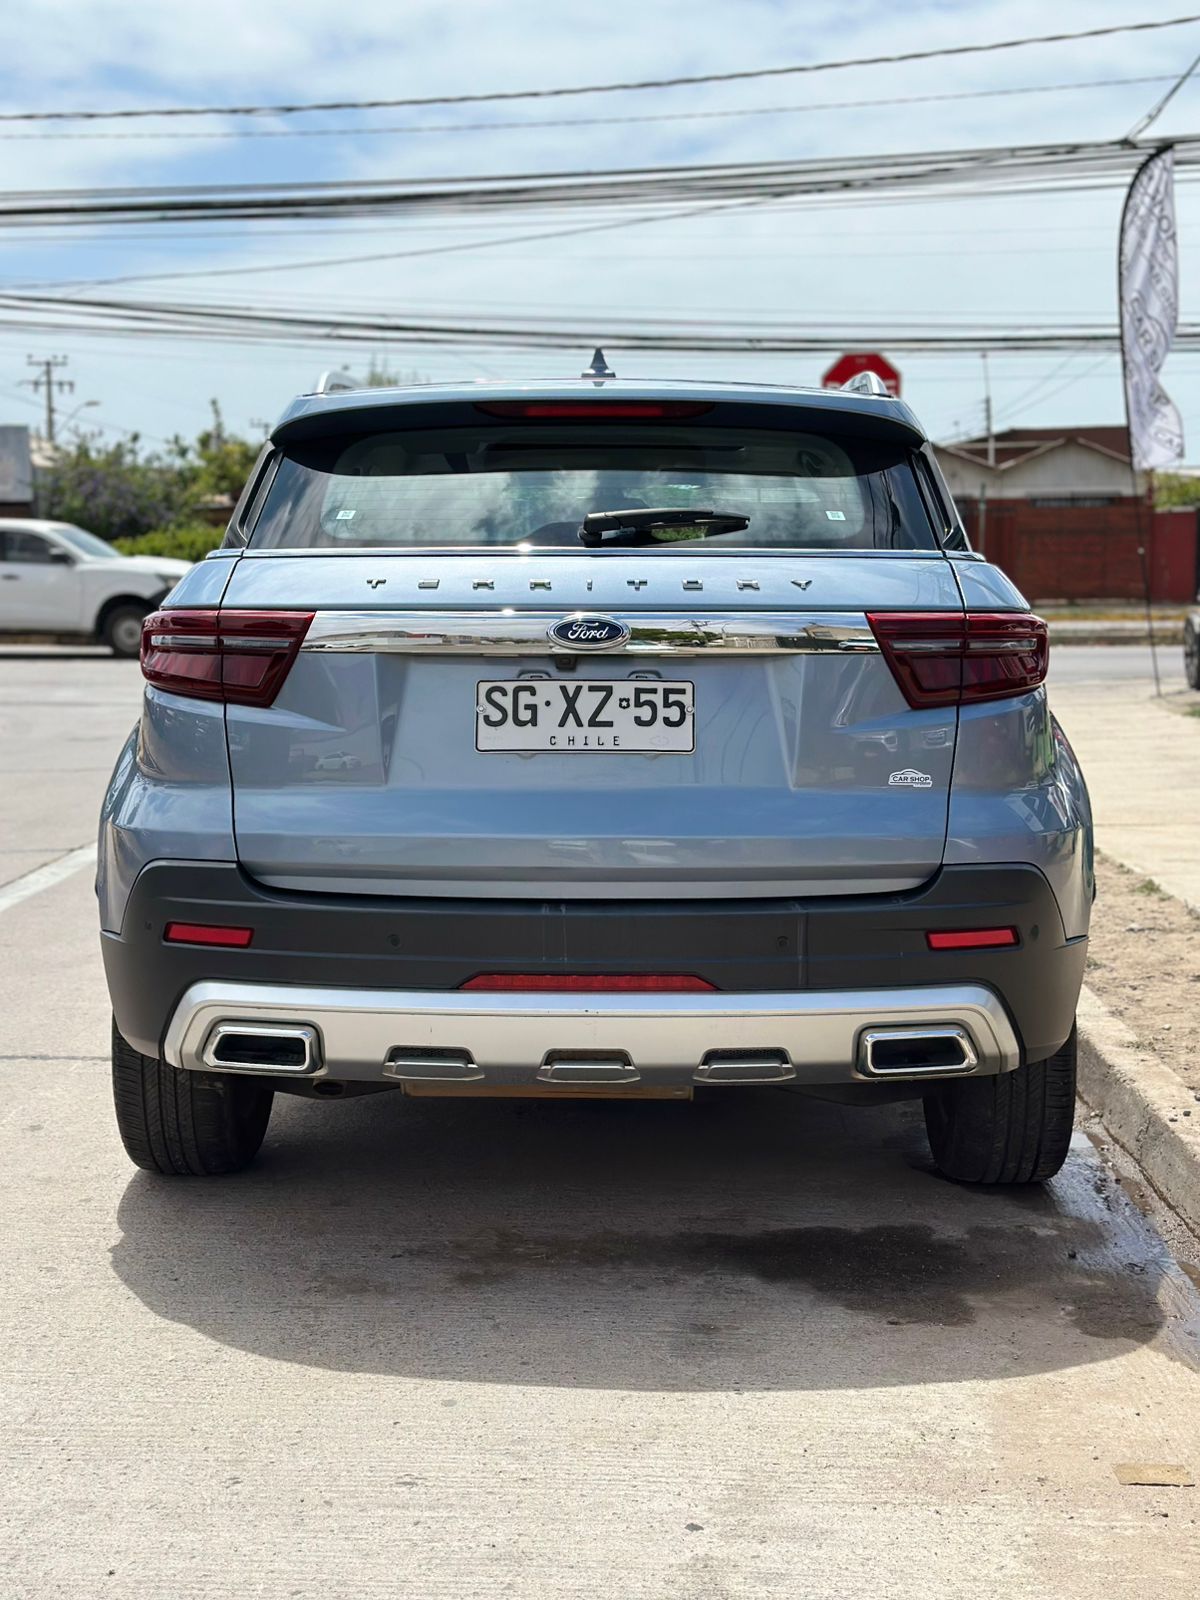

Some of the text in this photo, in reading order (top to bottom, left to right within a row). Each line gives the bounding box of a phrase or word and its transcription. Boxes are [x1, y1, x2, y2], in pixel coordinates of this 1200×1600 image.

[366, 578, 813, 591] TERRITORY
[567, 621, 609, 639] Ford
[549, 736, 620, 746] CHILE
